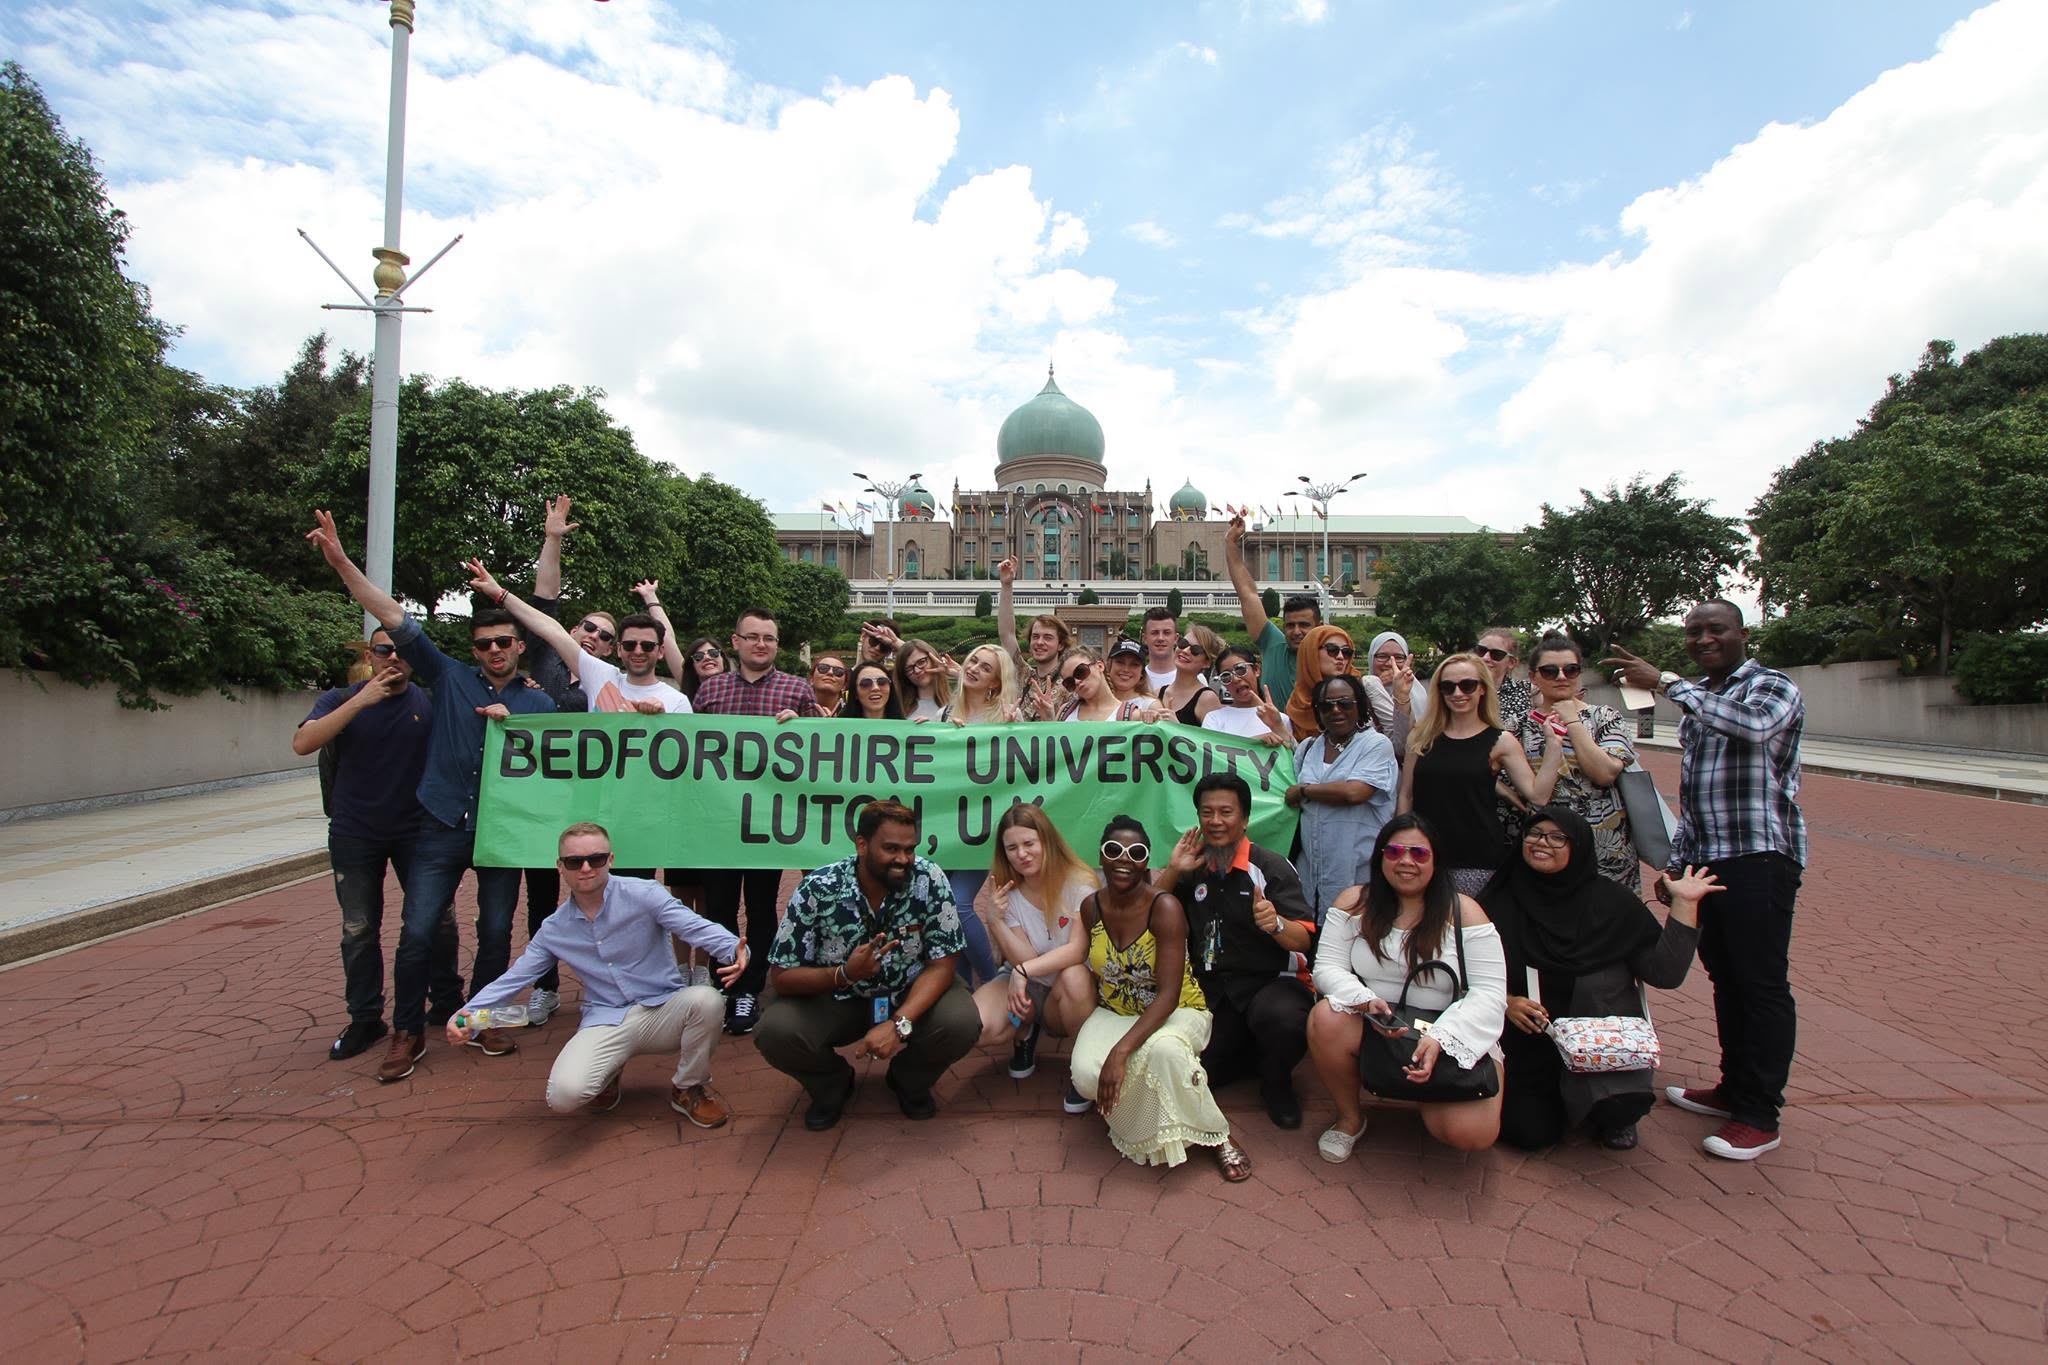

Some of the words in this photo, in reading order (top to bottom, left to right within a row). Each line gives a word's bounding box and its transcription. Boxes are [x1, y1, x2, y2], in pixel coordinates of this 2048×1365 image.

[500, 729, 935, 784] BEDFORDSHIRE
[966, 734, 1280, 791] UNIVERSITY
[957, 795, 1045, 847] U
